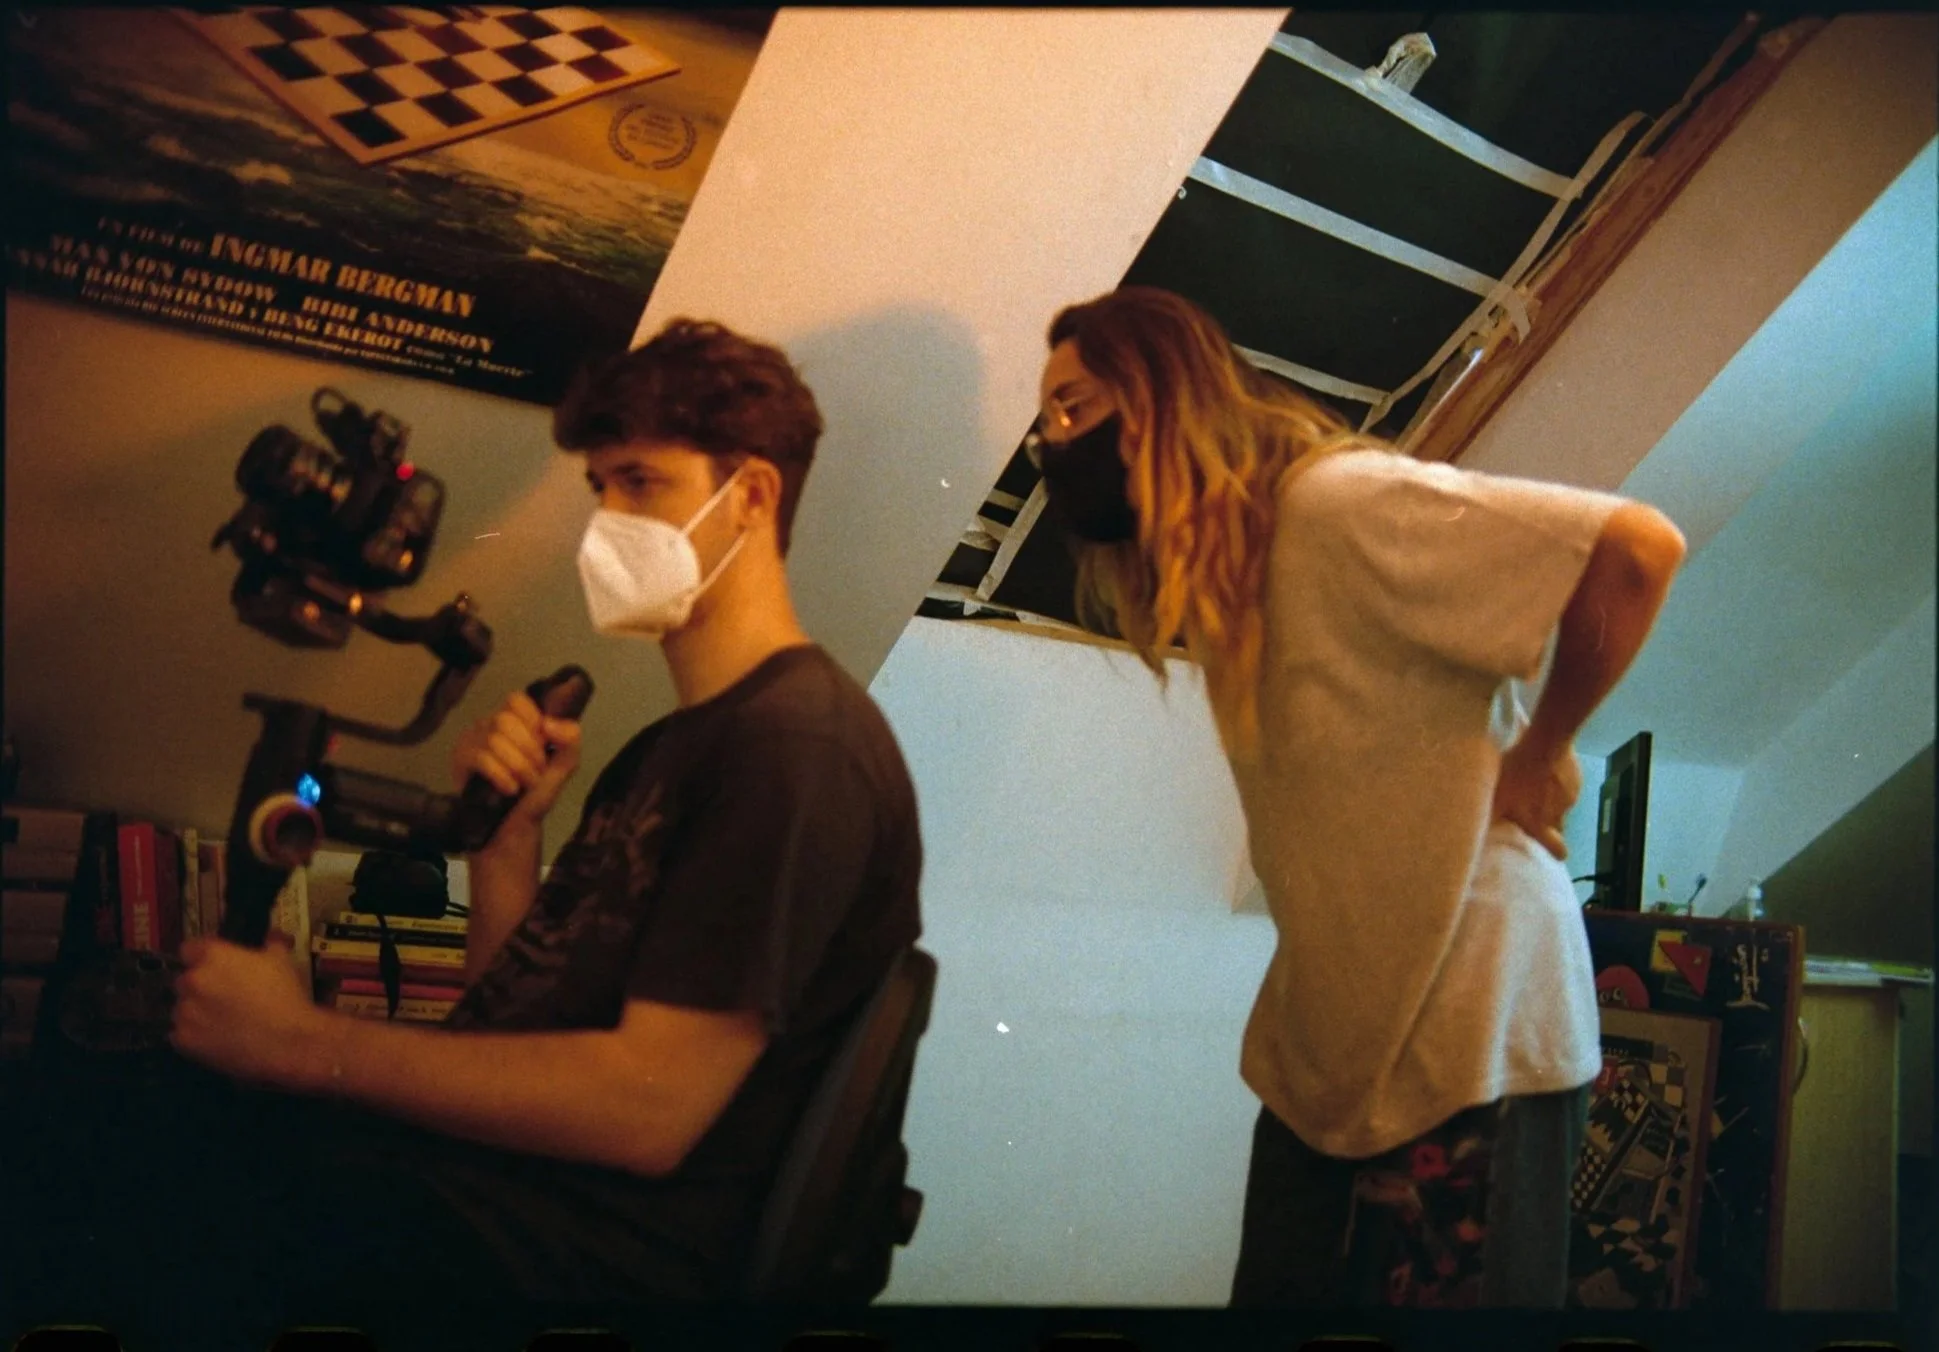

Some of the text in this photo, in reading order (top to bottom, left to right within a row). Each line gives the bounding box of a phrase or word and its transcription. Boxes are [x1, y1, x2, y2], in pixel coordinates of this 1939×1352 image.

[119, 250, 176, 281] VON
[181, 266, 277, 304] SYDOW
[302, 295, 360, 324] BIBI
[364, 311, 495, 355] ANDERSON
[209, 231, 332, 285] INGMAR
[335, 264, 477, 319] BERGMAN
[262, 306, 320, 334] BENG
[322, 321, 405, 352] EKEROT
